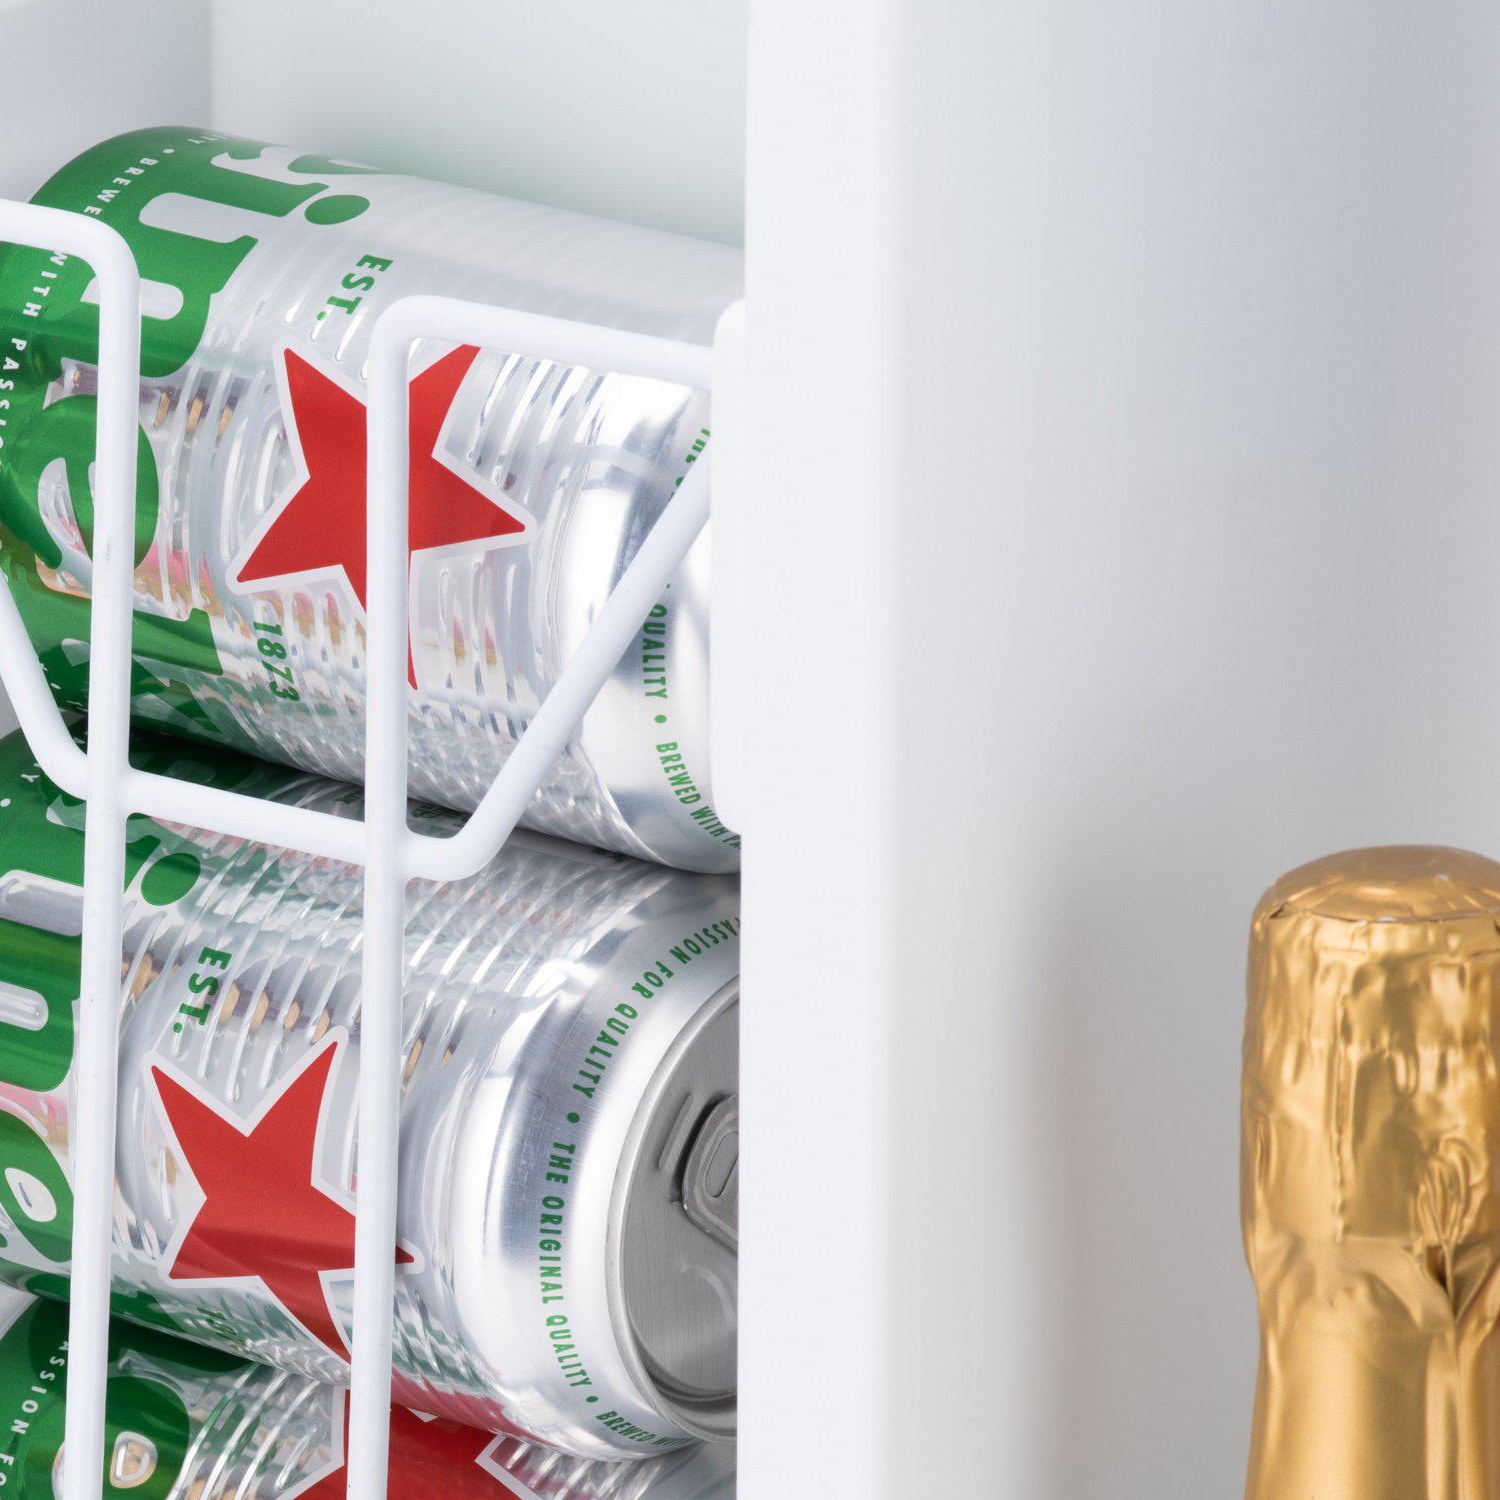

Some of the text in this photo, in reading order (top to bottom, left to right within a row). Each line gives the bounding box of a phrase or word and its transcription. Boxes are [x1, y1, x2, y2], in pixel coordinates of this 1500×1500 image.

[23, 249, 69, 318] WITH
[317, 254, 394, 321] EST.
[253, 621, 300, 702] 1873
[642, 600, 730, 839] QUALITY BREWED WITH
[172, 948, 233, 1035] EST.
[632, 960, 674, 1000] FOR
[572, 1003, 638, 1100] QUALITY
[539, 1142, 593, 1389] THE ORIGINAL QUALITY
[596, 1411, 654, 1446] BREWED
